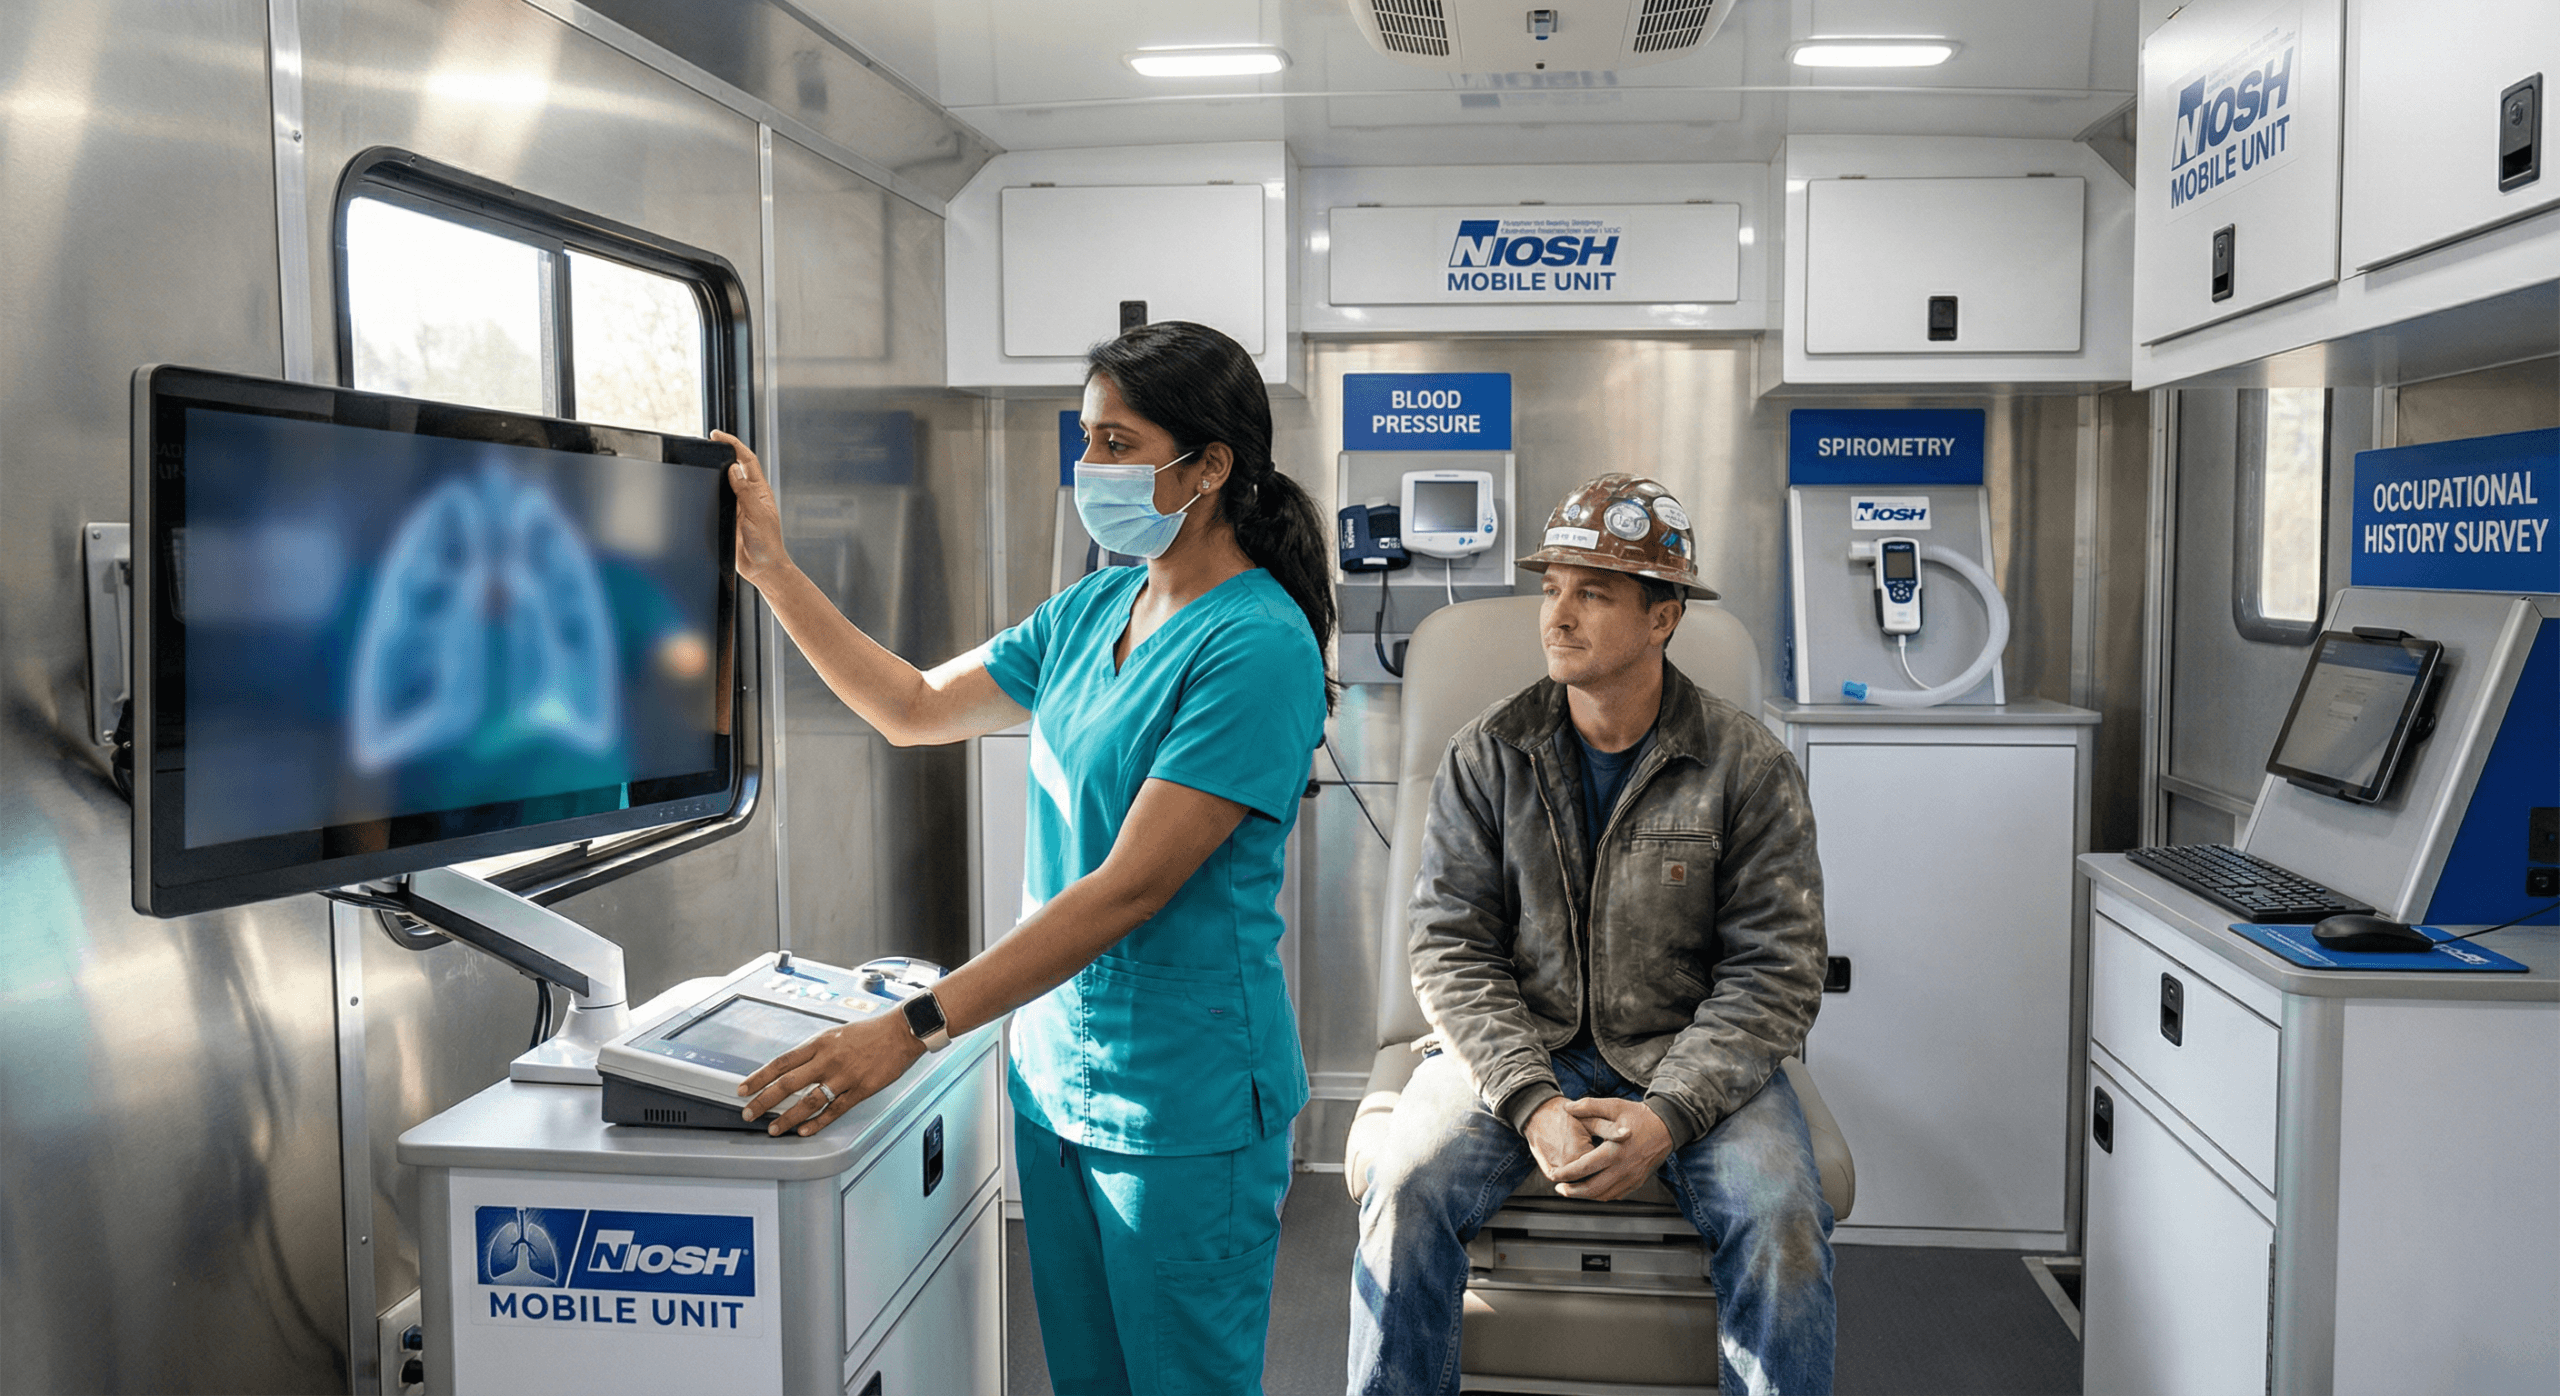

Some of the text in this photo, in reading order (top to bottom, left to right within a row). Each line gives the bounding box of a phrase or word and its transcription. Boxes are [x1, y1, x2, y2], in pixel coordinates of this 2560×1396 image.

[2171, 46, 2295, 173] NIOSH
[2171, 114, 2291, 210] MOBILE UNIT
[1448, 220, 1620, 268] NIOSH
[1447, 272, 1617, 292] MOBILE UNIT
[1391, 390, 1463, 410] BLOOD
[1371, 415, 1481, 434] PRESSURE
[1818, 437, 1956, 458] SPIROMETRY
[2373, 471, 2539, 513] OCCUPATIONAL
[1855, 502, 1927, 521] NIOSH
[2364, 518, 2550, 554] HISTORY SURVEY
[489, 1291, 744, 1329] MOBILE UNIT
